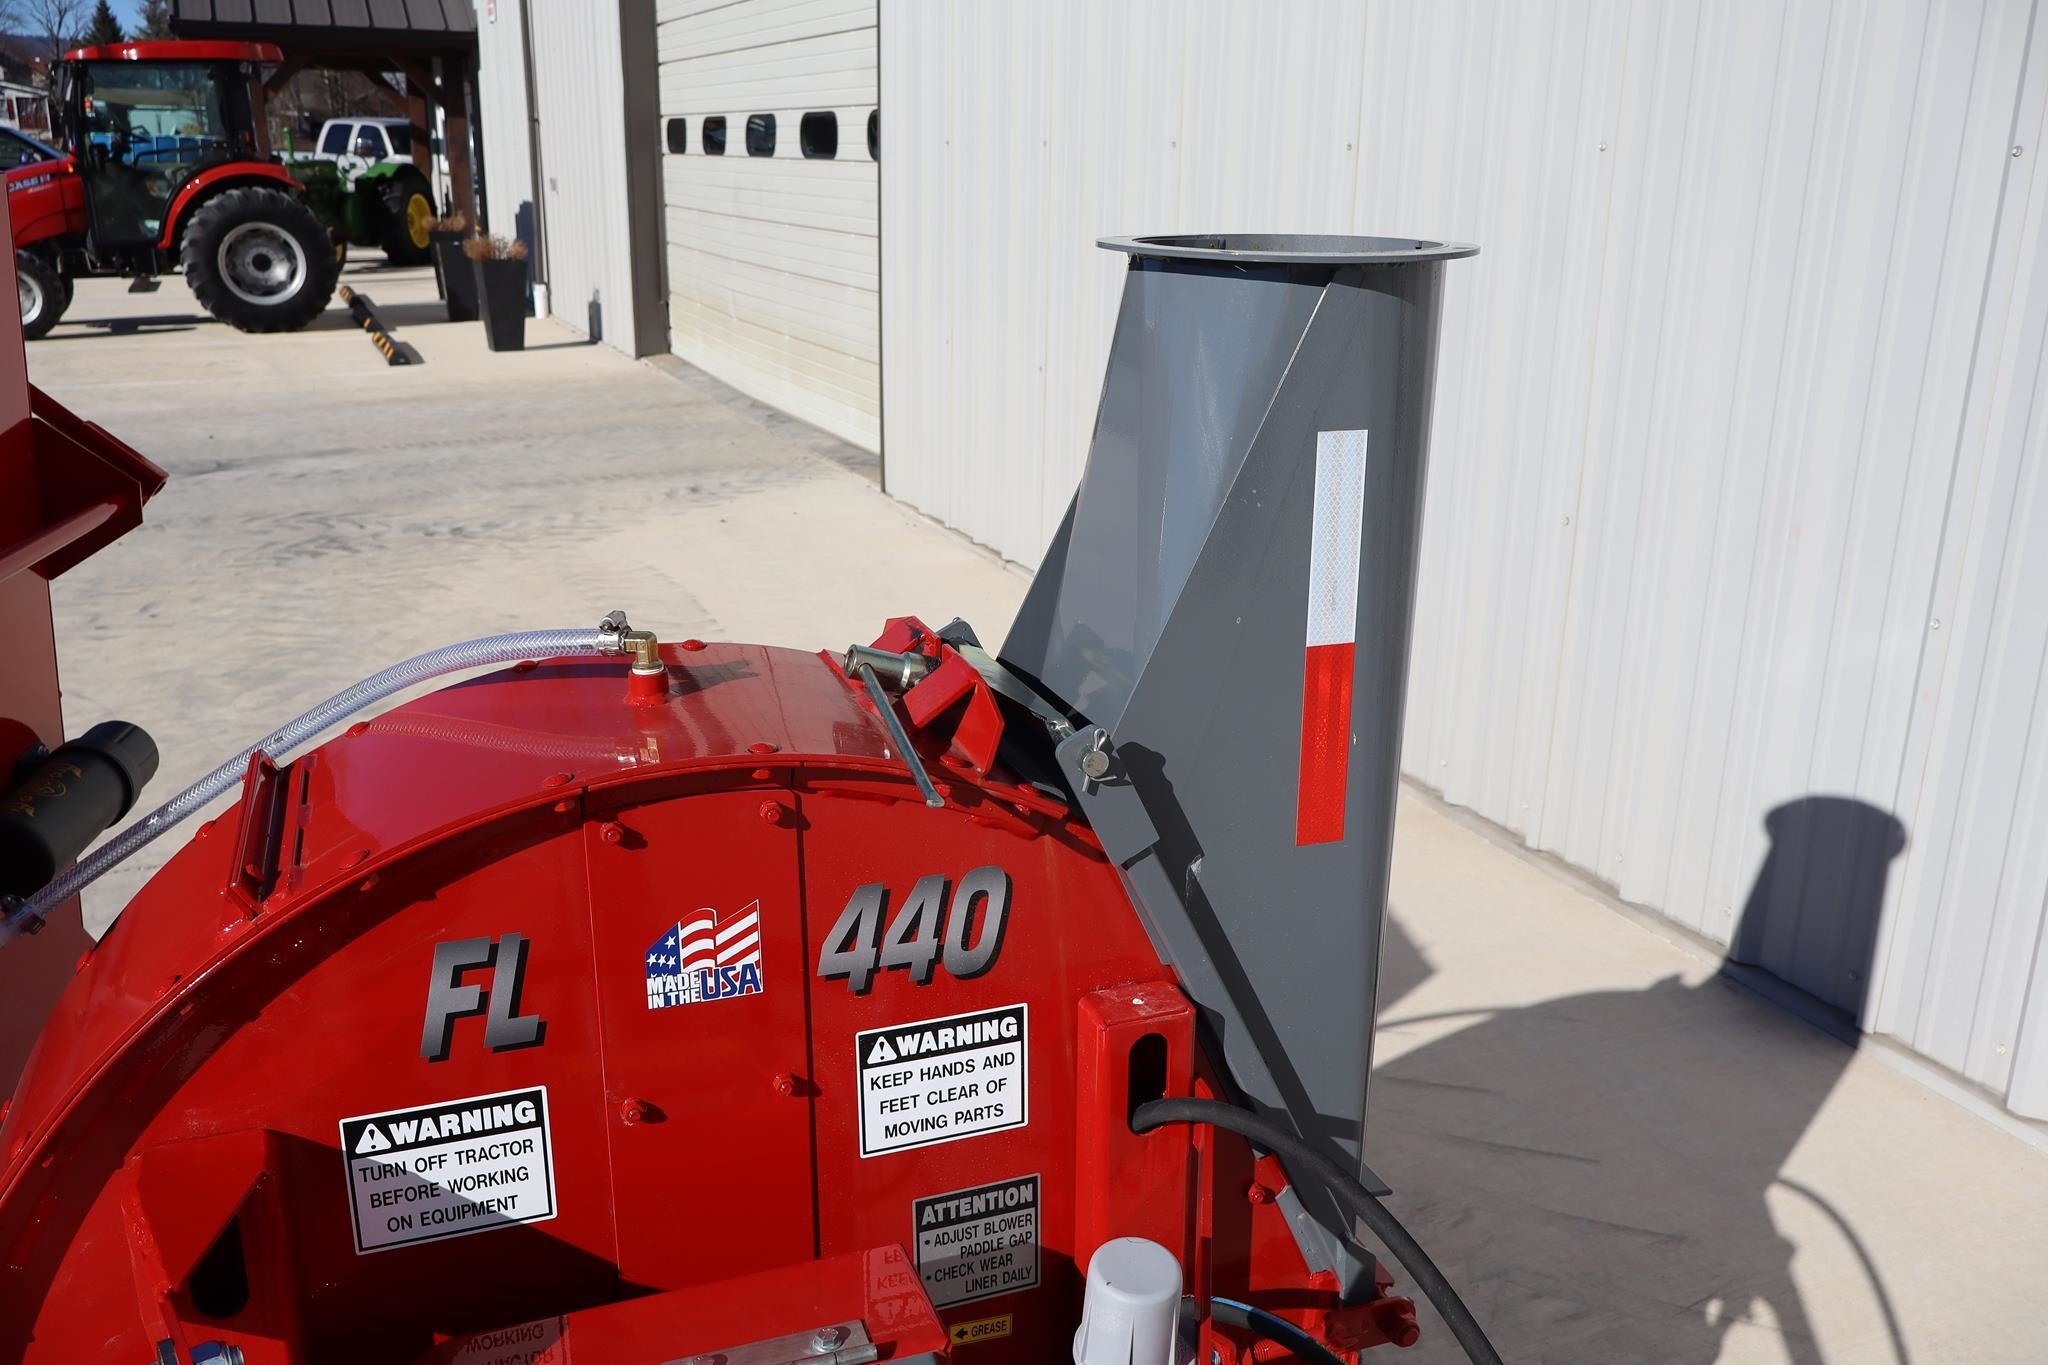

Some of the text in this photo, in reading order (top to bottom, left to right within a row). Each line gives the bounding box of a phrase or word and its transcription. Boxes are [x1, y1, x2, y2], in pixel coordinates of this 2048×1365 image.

[817, 865, 1013, 996] 440
[419, 932, 547, 1063] FL
[646, 971, 701, 995] MADE
[647, 988, 701, 1010] IN THE
[700, 962, 762, 1000] USA
[896, 1016, 1018, 1057] WARNING
[870, 1051, 1015, 1091] KEEP HANDS AND
[879, 1078, 1008, 1115] FEET CLEAR OF
[388, 1100, 537, 1146] WARNING
[884, 1103, 1004, 1140] MOVING PARTS
[358, 1138, 534, 1183] TURN OFF TRACTOR
[369, 1166, 529, 1209] BEFORE WORKING
[921, 1183, 1033, 1226] ATTENTION
[387, 1194, 519, 1233] ON EQUIPMENT
[934, 1213, 1033, 1248] ADJUST BLOWER
[960, 1230, 1033, 1260] PADDLE GAP
[934, 1252, 1014, 1283] CHECK WEAR
[965, 1265, 1033, 1294] LINER DAILY
[971, 1319, 1008, 1338] GREASE
